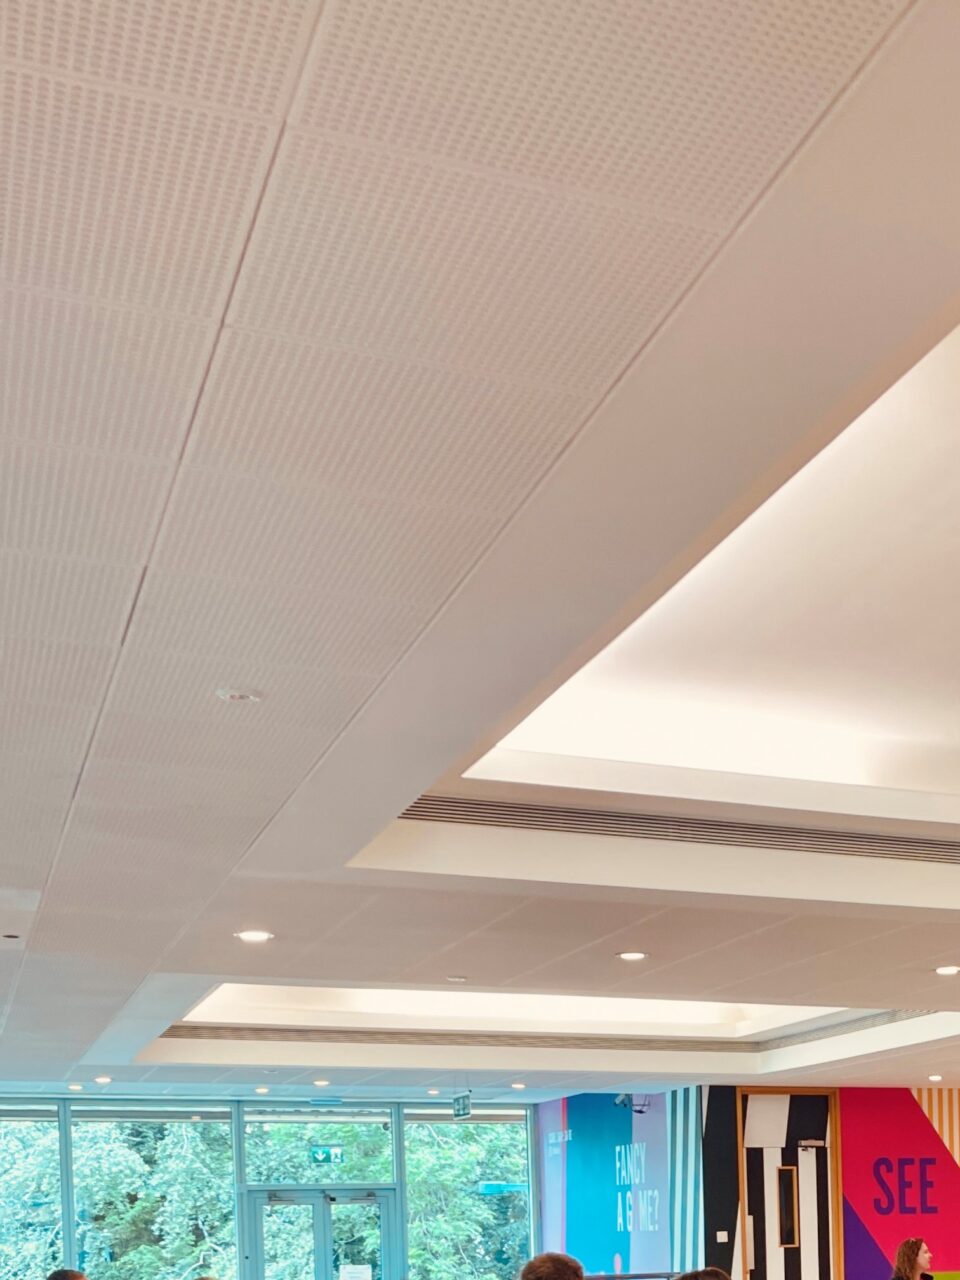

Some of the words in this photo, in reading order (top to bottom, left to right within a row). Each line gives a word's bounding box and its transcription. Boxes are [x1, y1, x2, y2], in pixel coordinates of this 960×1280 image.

[615, 1142, 646, 1185] FANCY
[873, 1157, 939, 1216] SEE
[617, 1191, 624, 1232] A
[626, 1189, 659, 1232] GAME?
